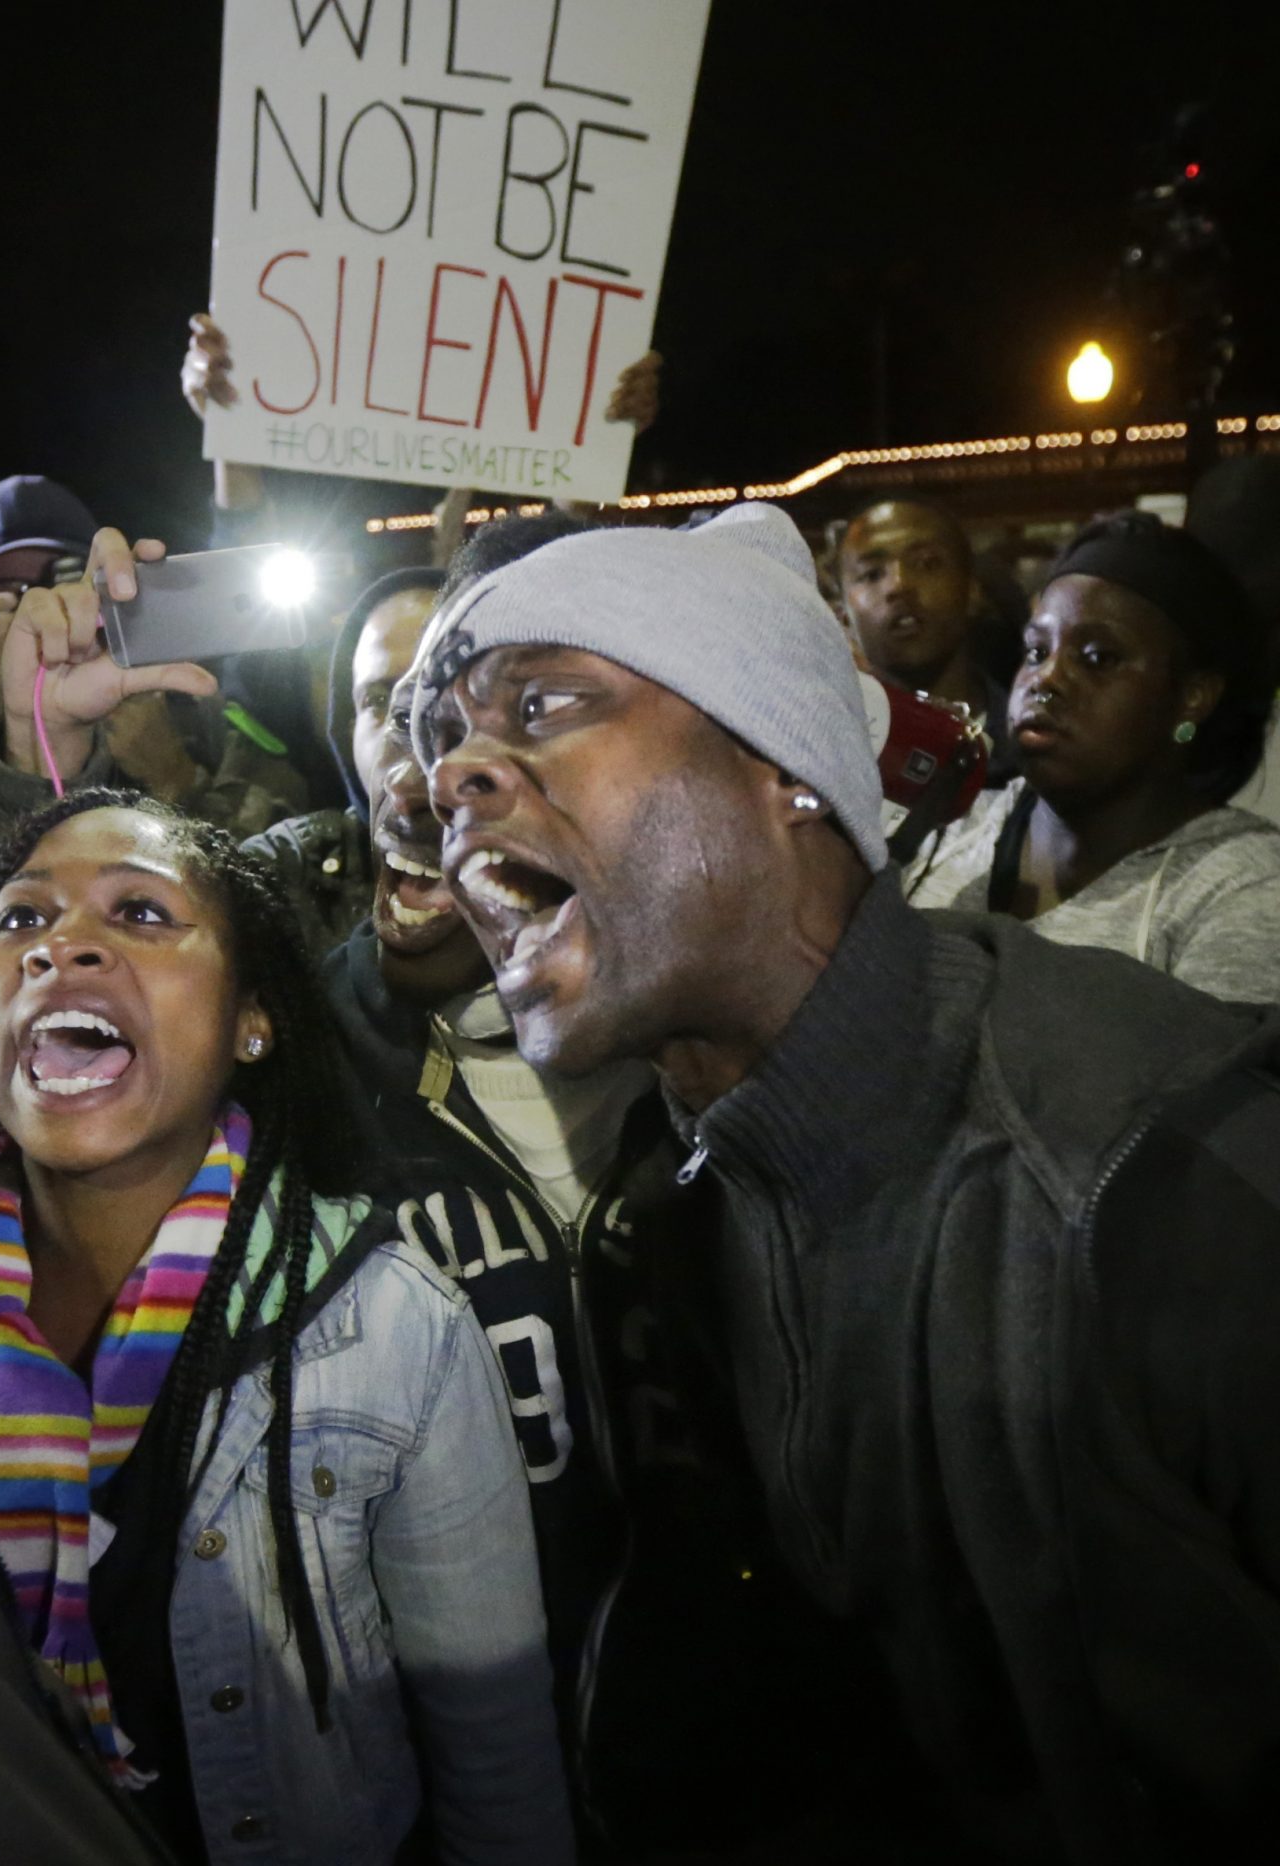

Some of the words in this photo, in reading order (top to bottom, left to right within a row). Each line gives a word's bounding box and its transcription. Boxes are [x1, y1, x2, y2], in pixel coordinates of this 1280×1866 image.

[251, 85, 485, 239] NOT
[494, 101, 649, 277] BE
[252, 250, 645, 447] SILENT
[265, 419, 573, 488] #OURLIVESMATTER
